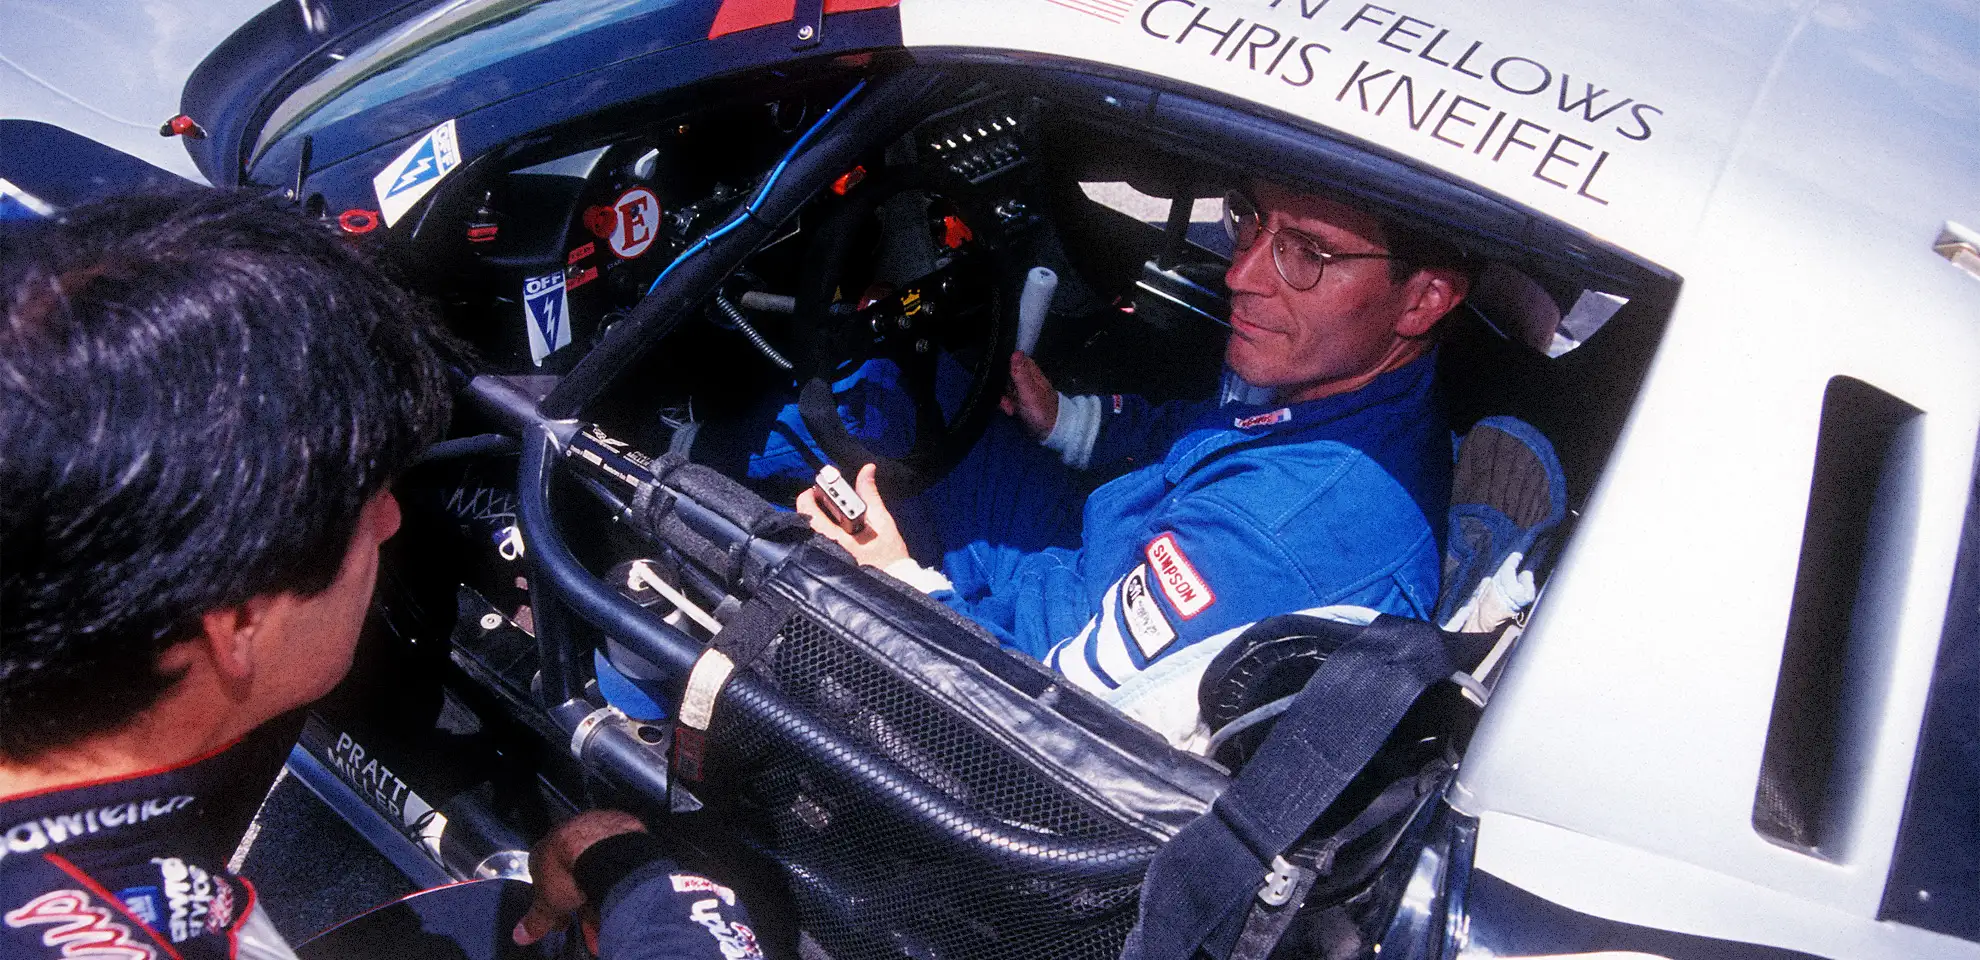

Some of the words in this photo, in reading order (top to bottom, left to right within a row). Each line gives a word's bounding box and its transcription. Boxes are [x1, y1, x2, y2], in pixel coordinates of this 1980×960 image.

[1140, 0, 1332, 87] CHRIS
[1335, 60, 1610, 206] KNEIFEL
[1341, 3, 1664, 142] FELLOWS
[436, 124, 457, 171] OFF
[618, 195, 650, 251] E
[526, 271, 564, 295] OFF
[1153, 544, 1197, 603] SIMPSON
[327, 746, 400, 817] MILLER
[336, 731, 408, 802] PRATT
